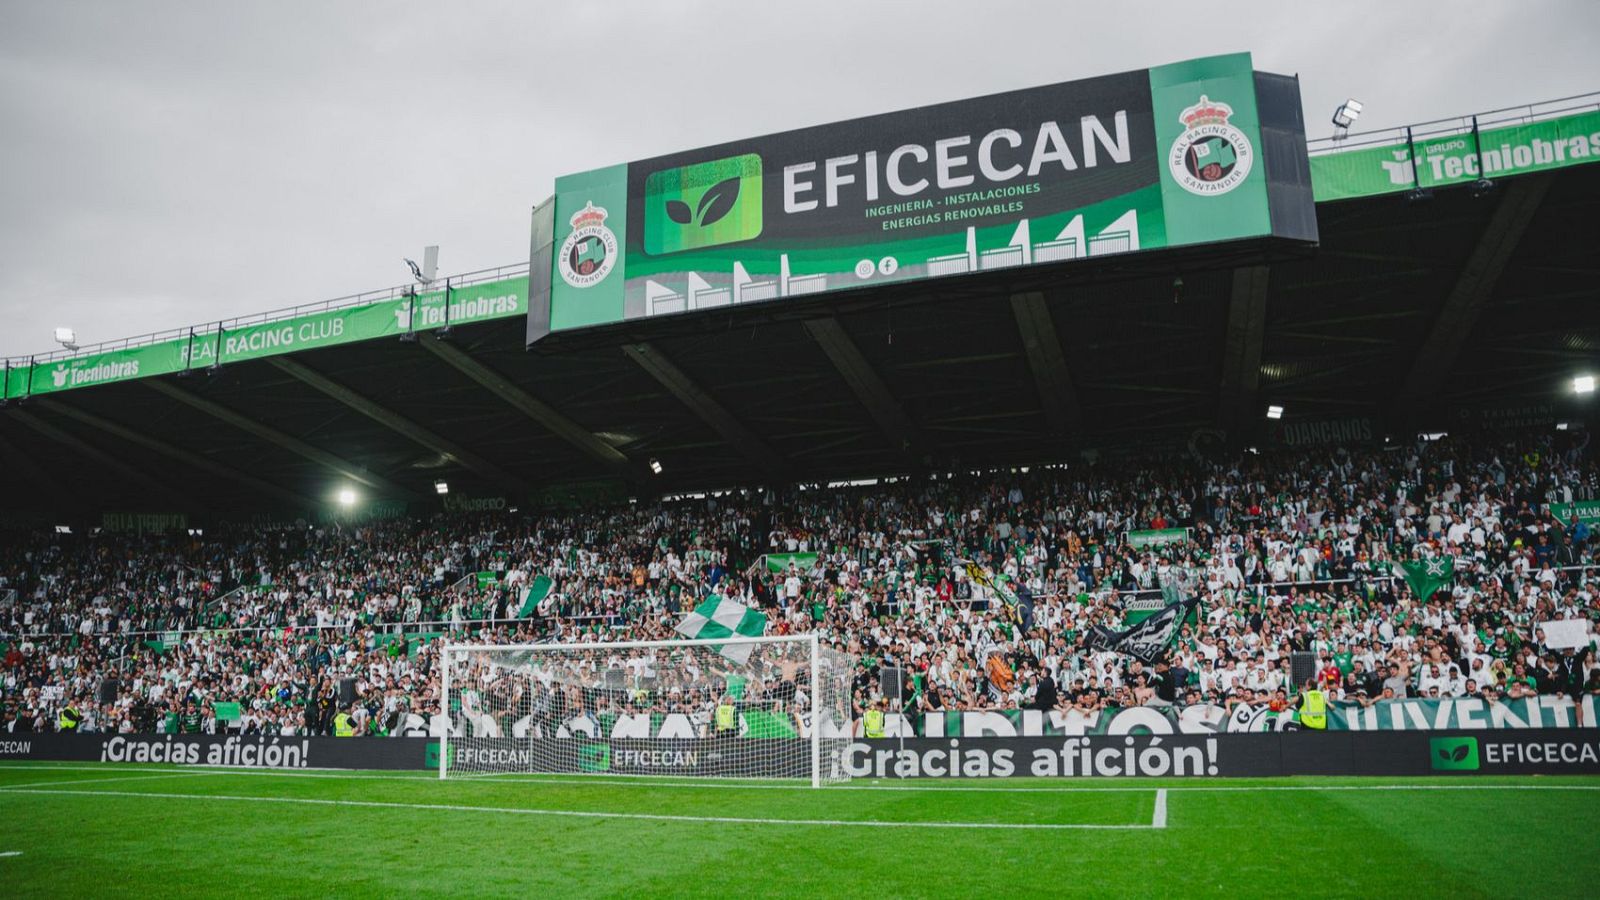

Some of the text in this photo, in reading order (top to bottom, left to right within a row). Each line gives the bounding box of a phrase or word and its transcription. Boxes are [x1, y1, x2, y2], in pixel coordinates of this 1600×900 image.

[1174, 126, 1248, 166] REAL RACING CLUB
[1425, 140, 1466, 155] GRUPO
[1426, 132, 1600, 180] Tecniobras
[783, 109, 1131, 214] EFICECAN
[1183, 169, 1242, 191] SANTANDER
[865, 198, 934, 218] INGENIERIA
[945, 182, 1041, 206] INSTALACIONES
[882, 201, 1024, 231] ENERGIAS RENOVABLES
[566, 265, 609, 284] SANTANDER
[420, 293, 518, 326] Tecniobras
[180, 318, 344, 362] REAL RACING CLUB
[70, 359, 140, 385] Tecniobras
[0, 741, 31, 754] CECAN
[101, 735, 309, 767] ¡Gracias afición!
[456, 748, 530, 765] EFICECAN
[614, 750, 699, 767] EFICECAN
[829, 736, 1219, 779] ¡Gracias afición!
[1485, 742, 1600, 764] EFICECA
